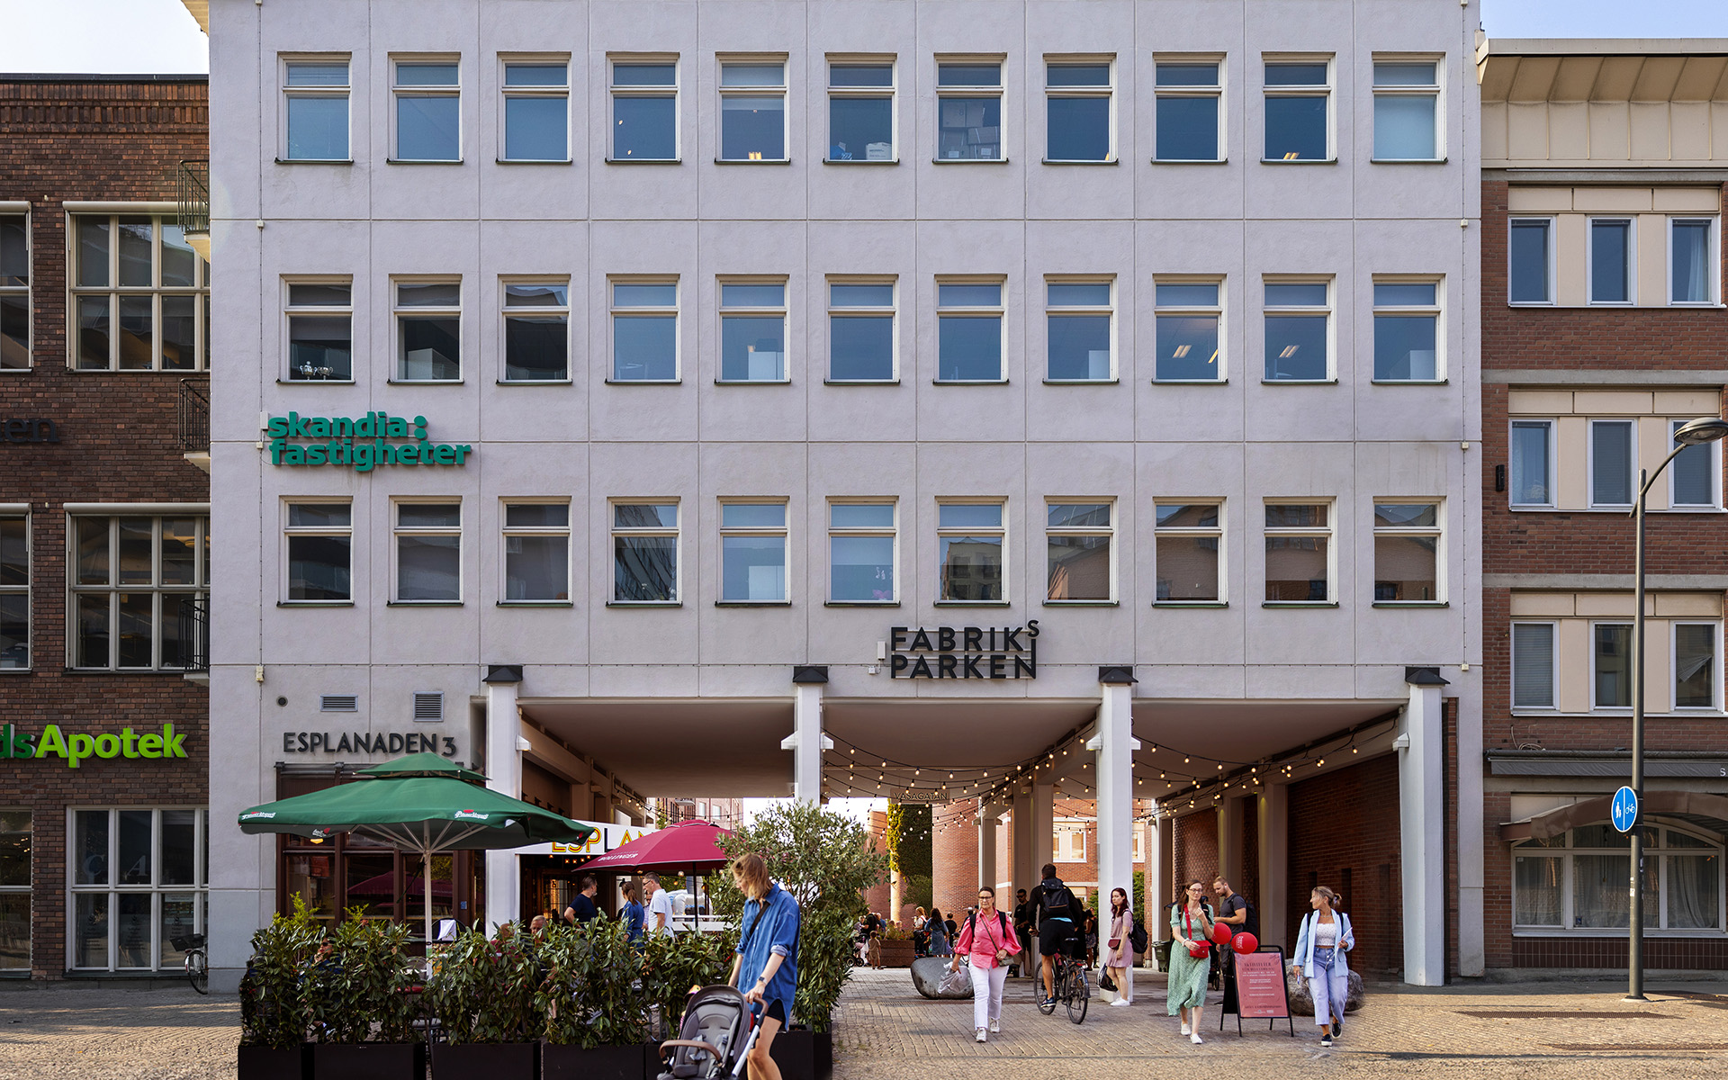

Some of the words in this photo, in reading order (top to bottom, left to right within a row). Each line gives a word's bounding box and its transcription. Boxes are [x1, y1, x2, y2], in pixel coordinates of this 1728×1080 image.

[0, 418, 60, 442] en
[269, 438, 471, 472] fastigheter
[891, 639, 1037, 679] PARKEN
[283, 732, 437, 754] ESPLANADEN
[442, 737, 457, 757] 3
[894, 792, 948, 800] VASAGATAN
